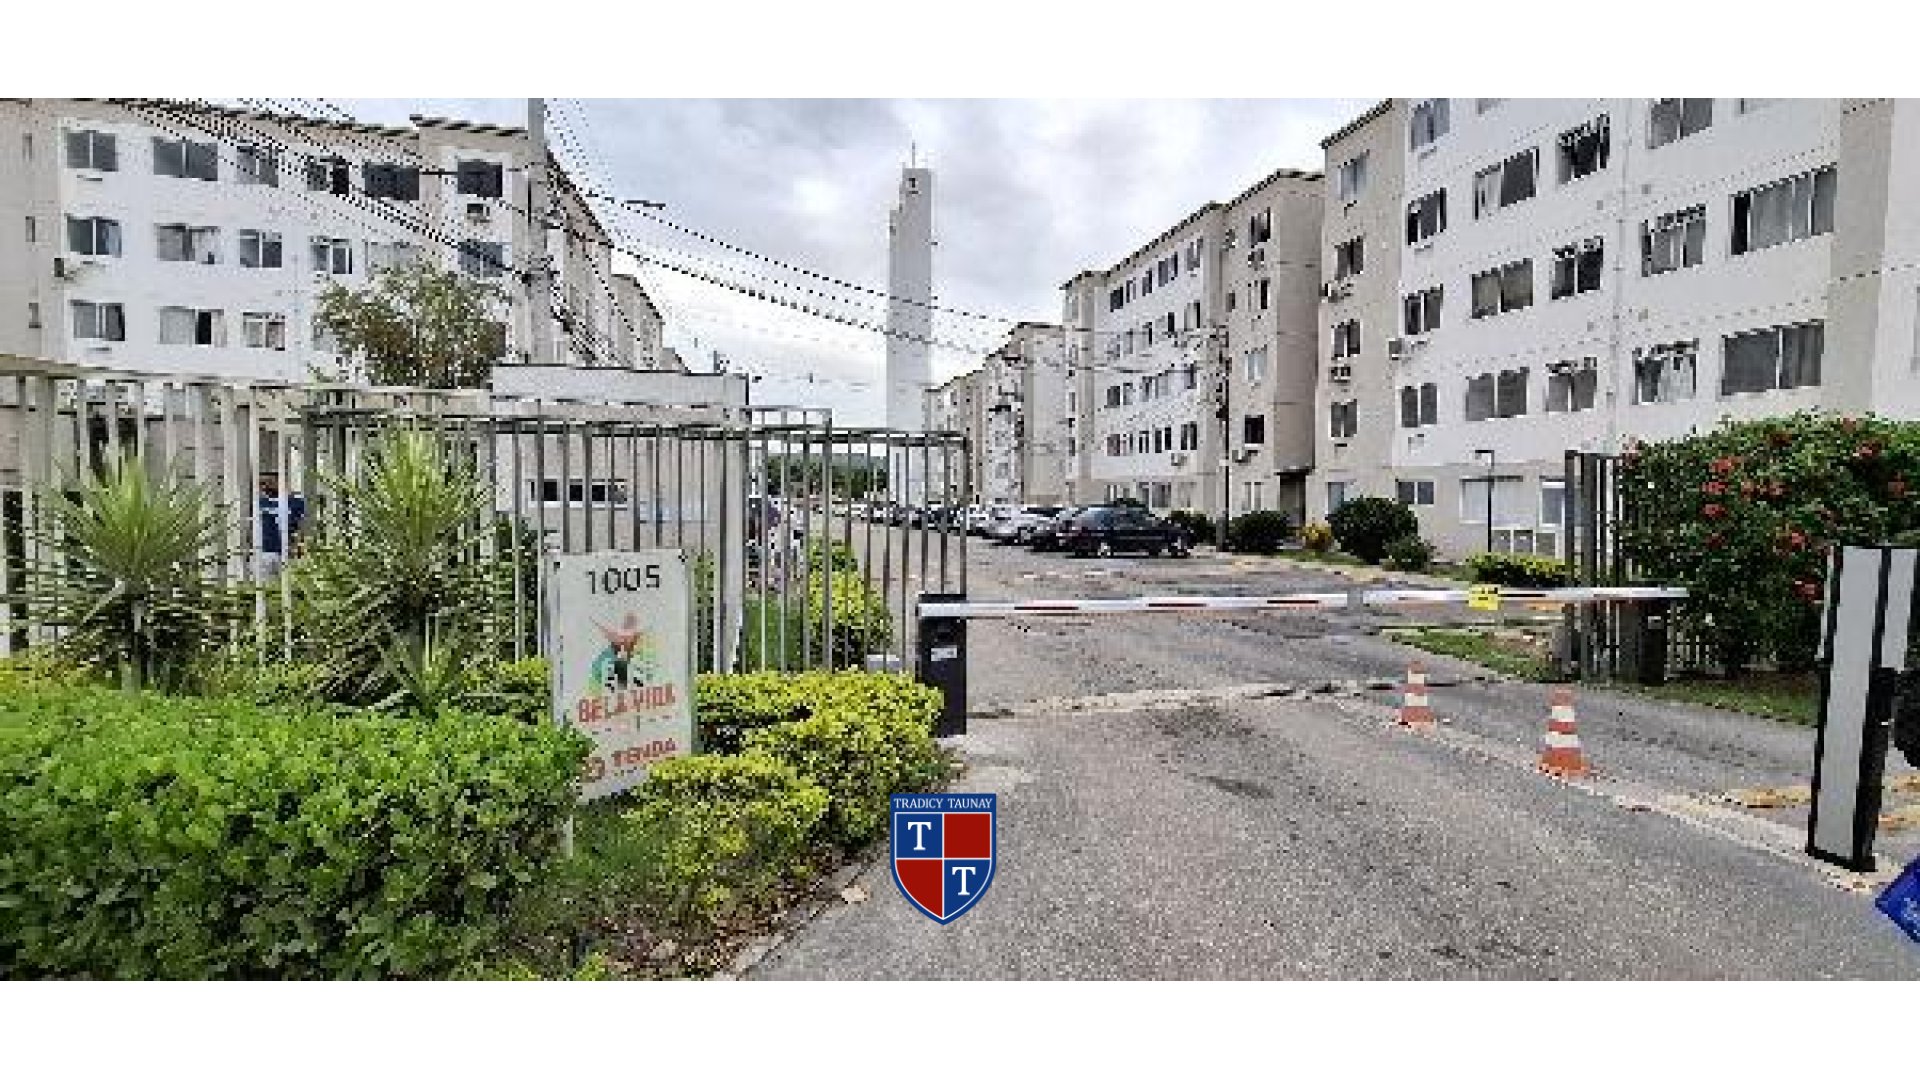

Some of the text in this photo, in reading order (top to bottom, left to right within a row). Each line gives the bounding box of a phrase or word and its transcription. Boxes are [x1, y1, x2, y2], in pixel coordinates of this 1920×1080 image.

[586, 564, 661, 594] 1005
[578, 683, 676, 722] BELA VIDA
[612, 738, 677, 767] TENDA
